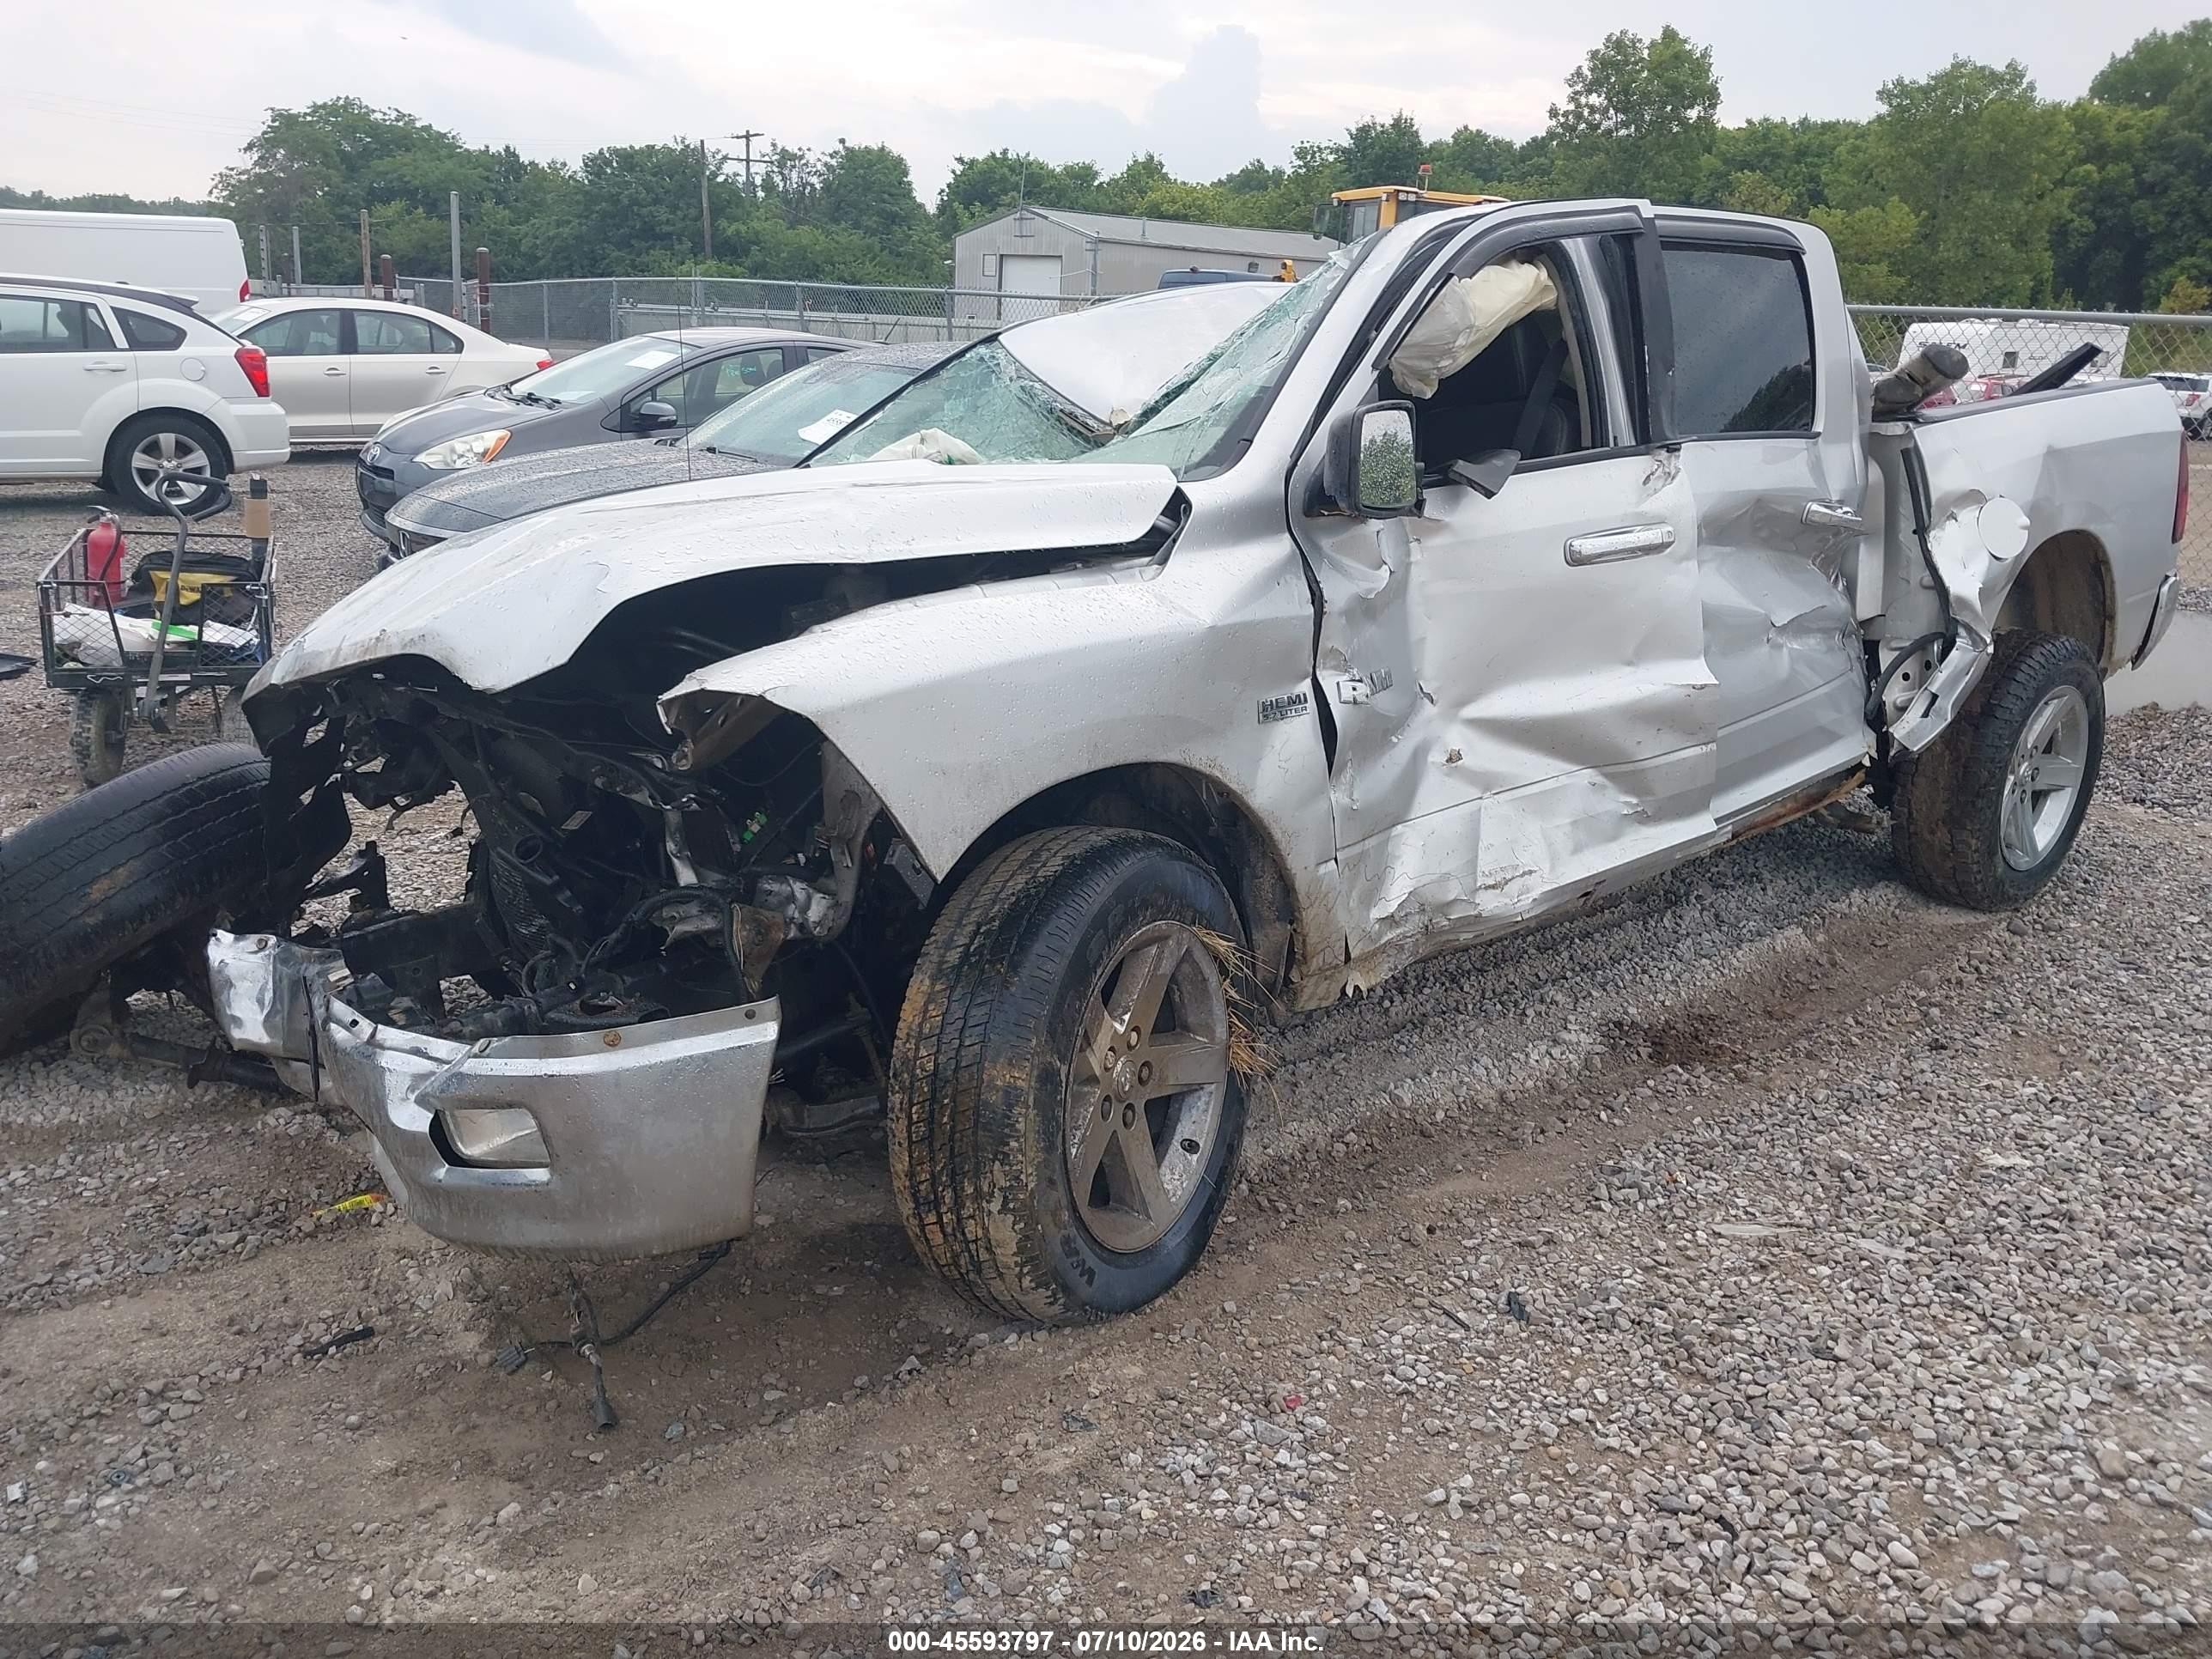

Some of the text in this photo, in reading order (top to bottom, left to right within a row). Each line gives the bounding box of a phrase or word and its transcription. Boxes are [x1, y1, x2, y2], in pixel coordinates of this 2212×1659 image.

[1261, 692, 1309, 712] HEMI
[1263, 705, 1309, 722] 5.7 LITER
